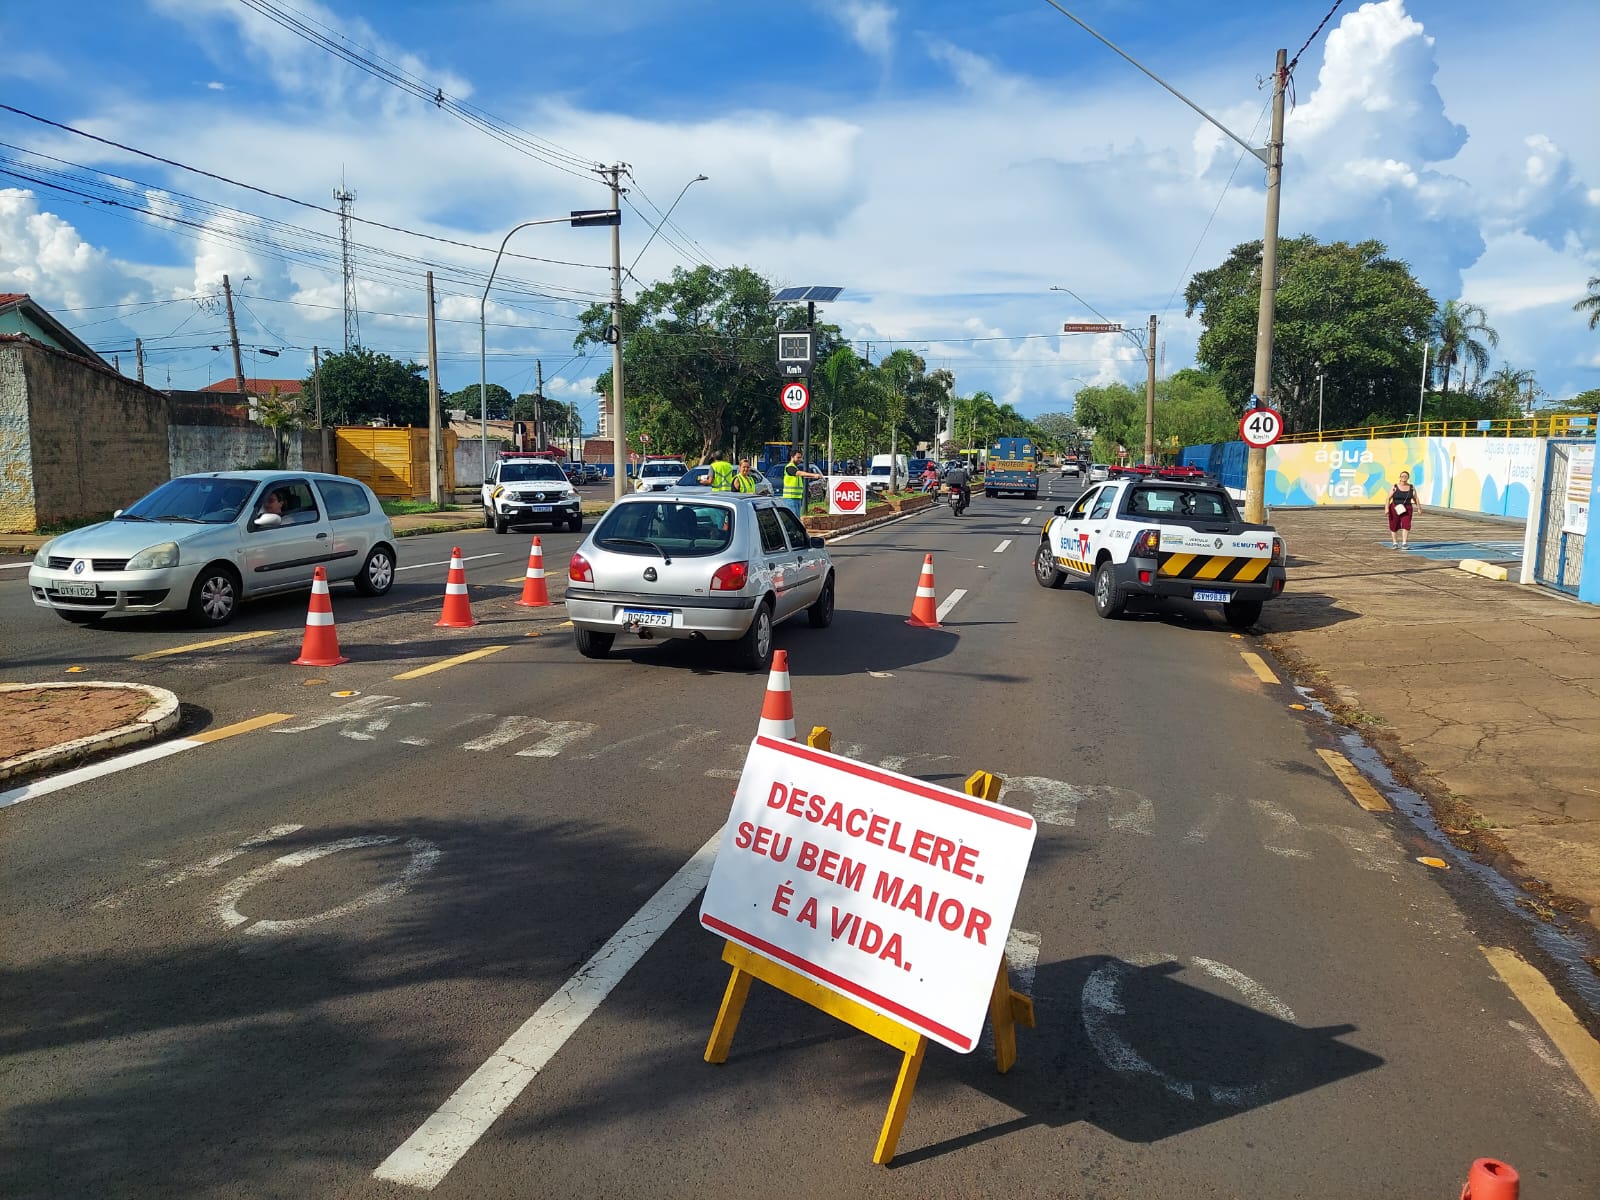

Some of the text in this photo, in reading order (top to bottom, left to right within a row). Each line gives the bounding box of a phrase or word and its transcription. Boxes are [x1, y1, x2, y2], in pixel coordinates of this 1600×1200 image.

[787, 389, 802, 401] 40
[1249, 416, 1274, 433] 40
[1314, 444, 1374, 469] água
[834, 489, 861, 502] PARE
[1315, 479, 1364, 497] vida
[766, 780, 985, 885] DESACELERE.
[735, 820, 992, 946] SEU BEM MAIOR
[771, 879, 913, 973] É A VIDA.
